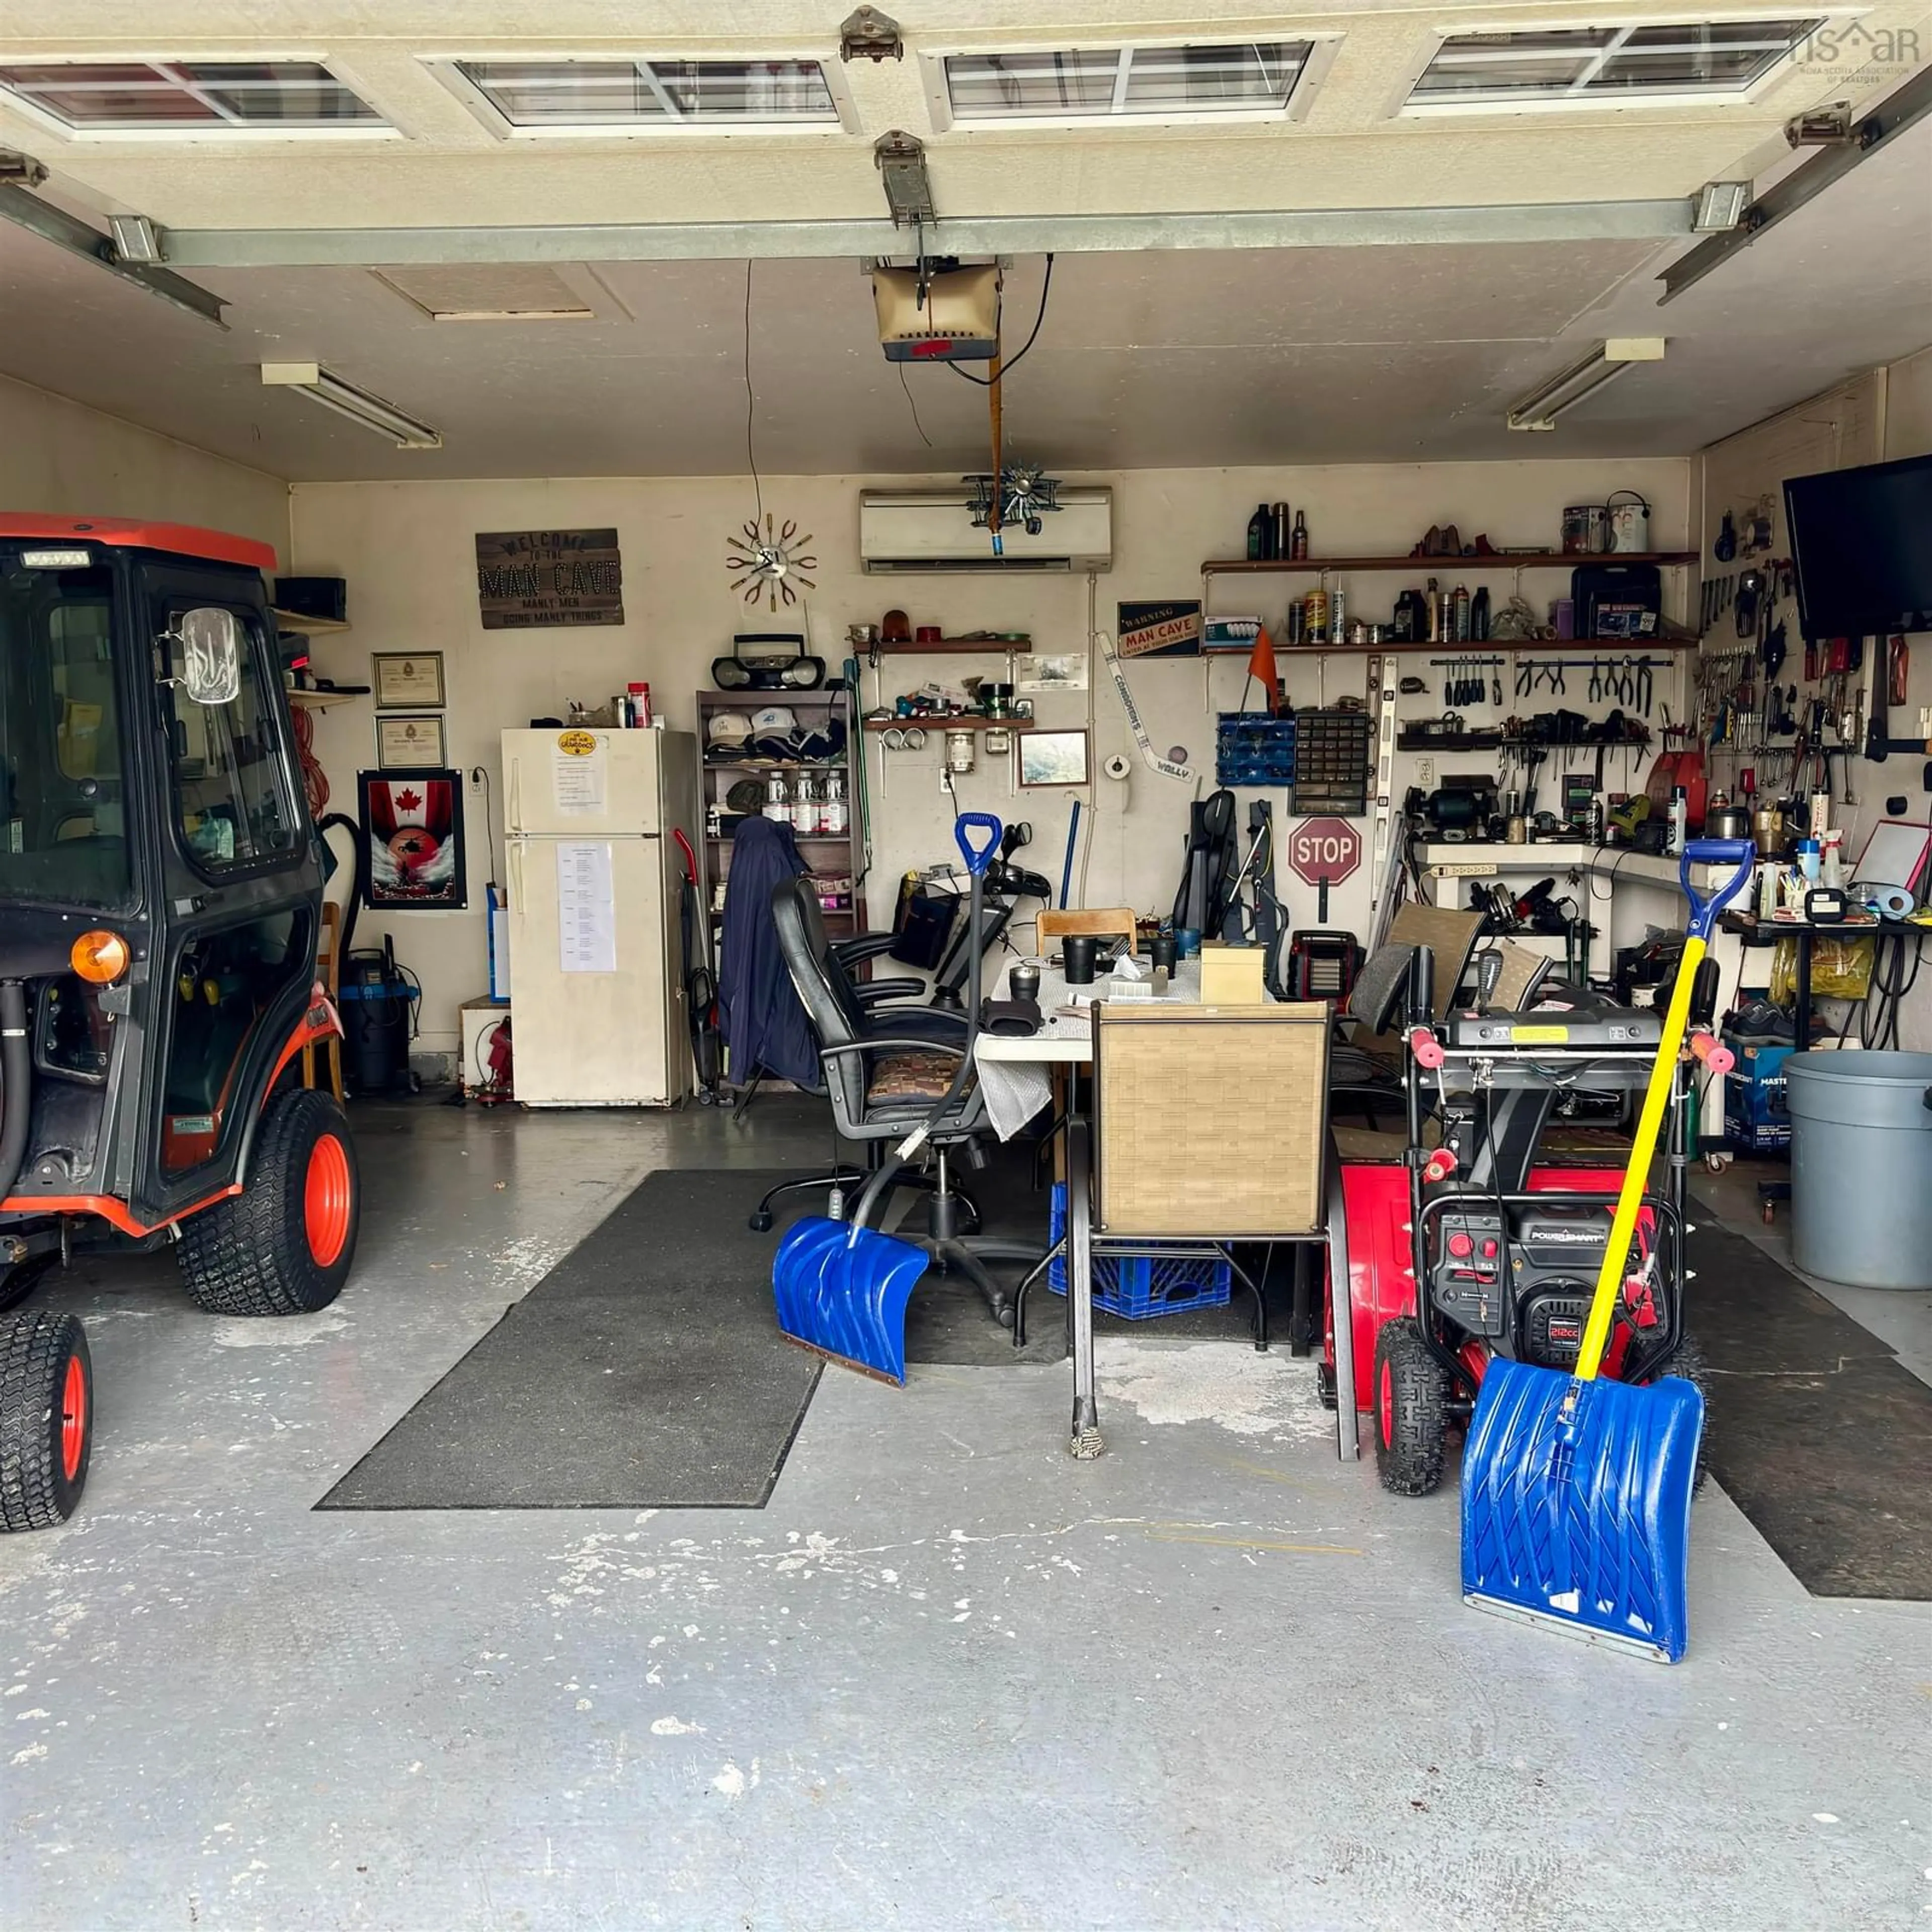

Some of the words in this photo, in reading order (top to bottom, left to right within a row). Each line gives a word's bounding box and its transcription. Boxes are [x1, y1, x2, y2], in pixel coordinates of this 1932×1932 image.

[500, 532, 586, 556] WELCOME
[530, 550, 541, 560] TO
[545, 549, 564, 560] THE
[480, 563, 541, 599] MAN
[555, 560, 620, 595] CAVE
[523, 598, 554, 610] MANLY
[559, 597, 580, 608] MEN
[534, 612, 567, 624] MANLY
[1123, 606, 1174, 628] WARNING
[1126, 629, 1154, 648] MAN
[1158, 618, 1192, 637] CAVE
[1297, 837, 1353, 864] STOP
